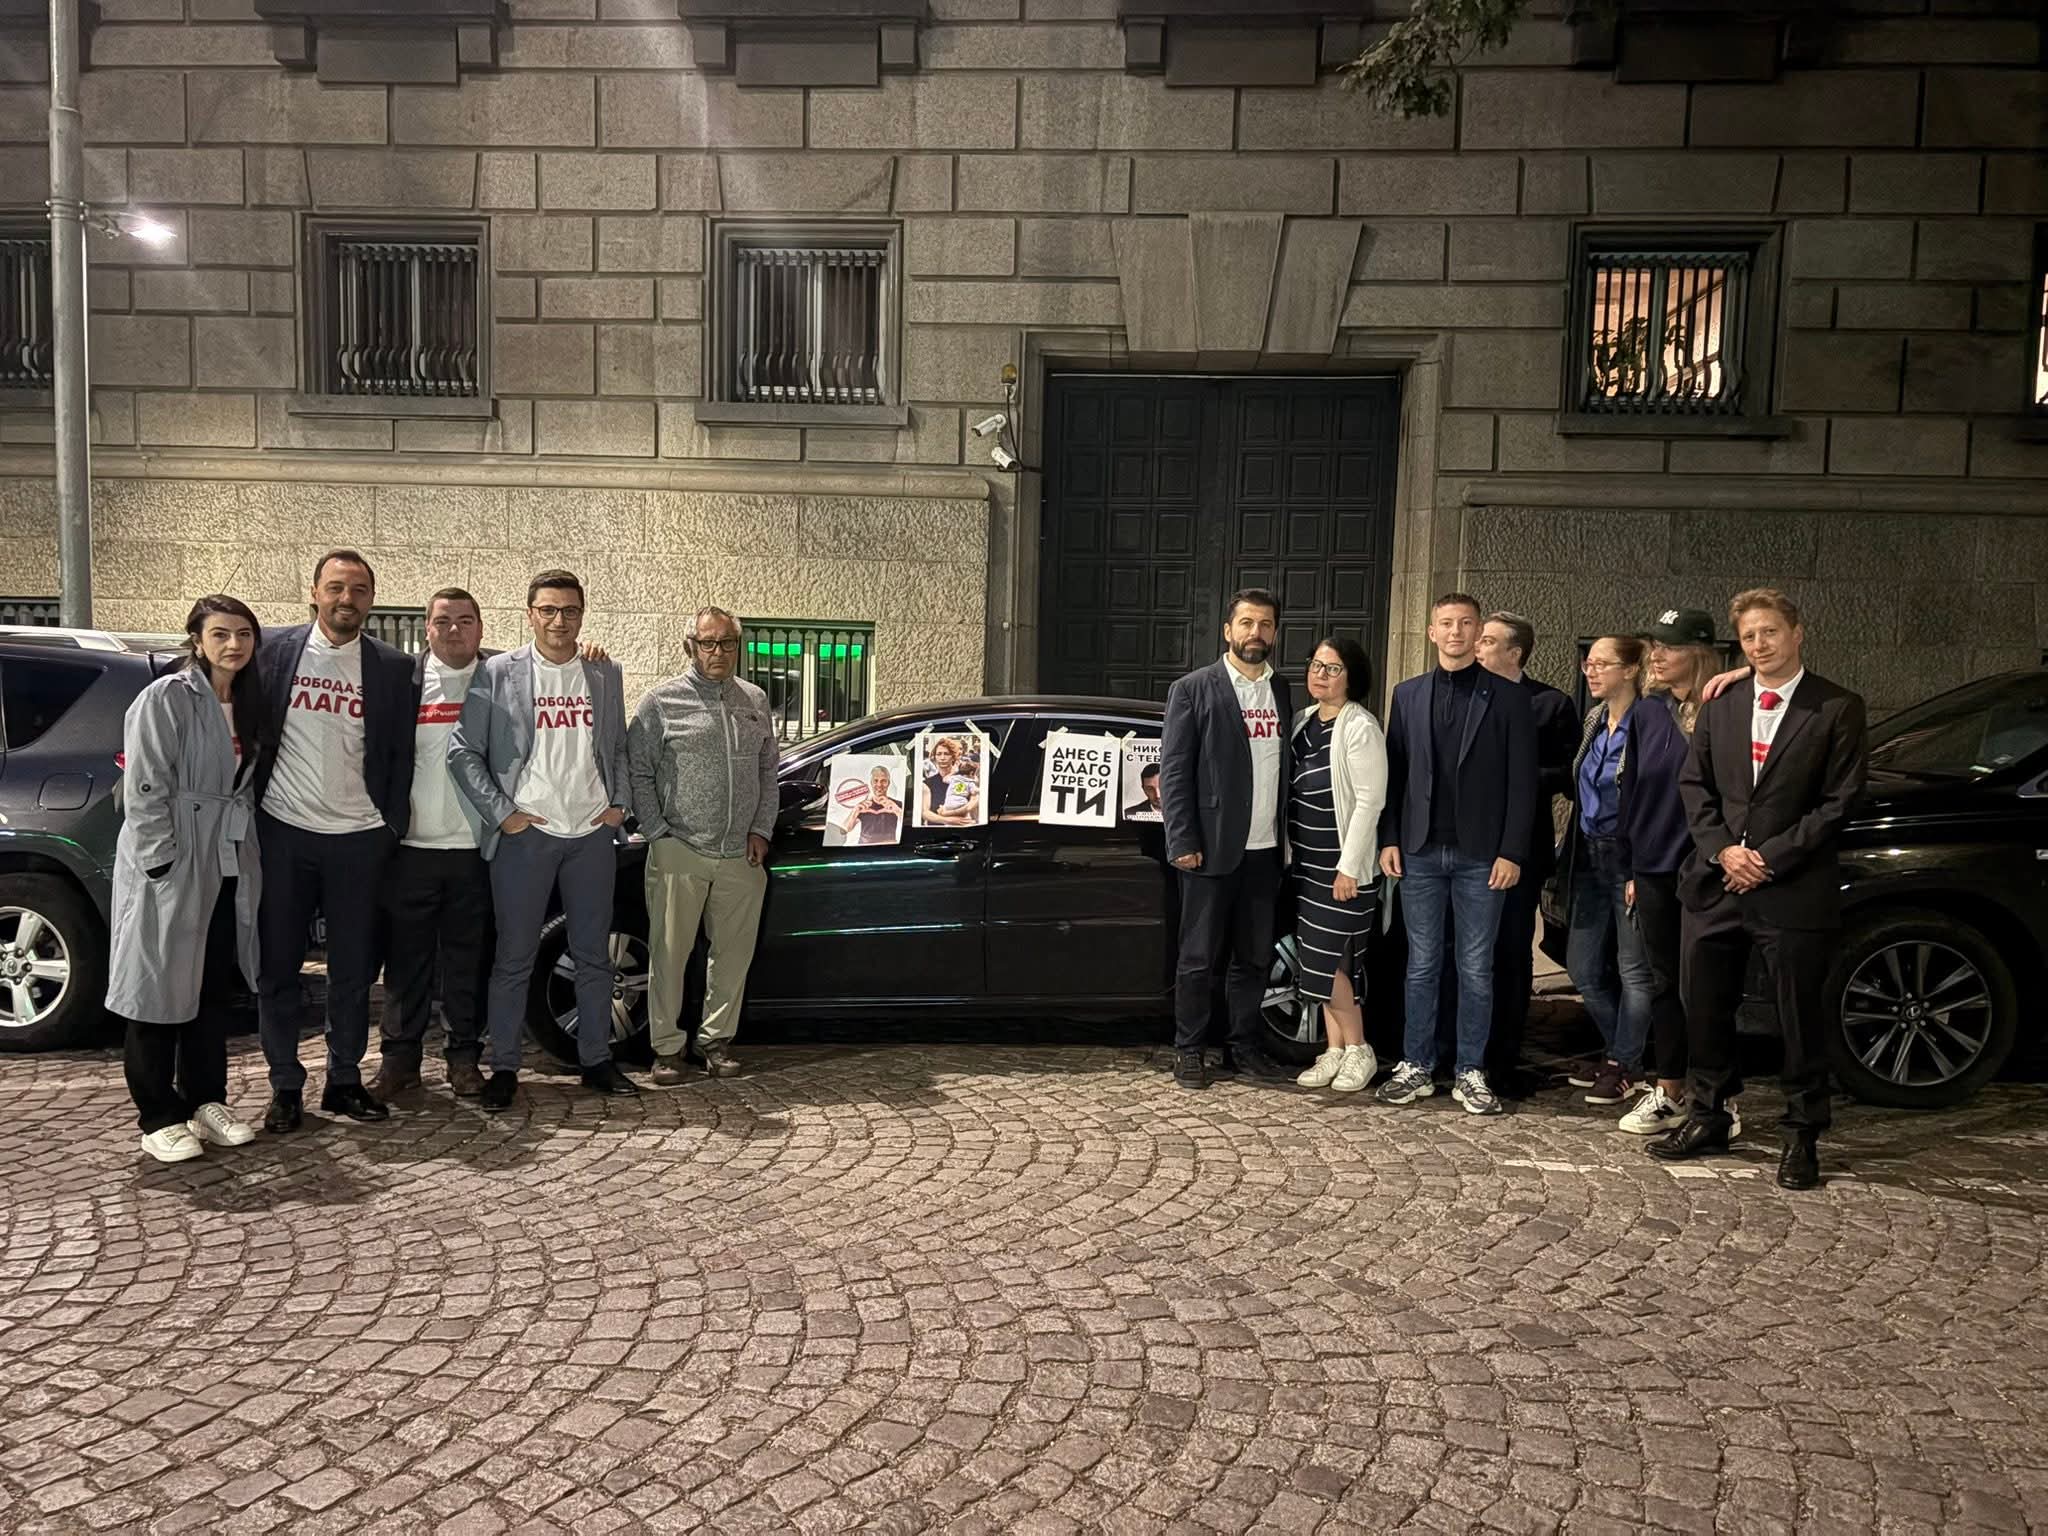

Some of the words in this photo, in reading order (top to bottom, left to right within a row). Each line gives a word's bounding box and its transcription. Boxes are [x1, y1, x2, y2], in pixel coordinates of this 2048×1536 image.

[292, 675, 354, 694] ВОБОДА
[288, 690, 366, 719] ЛАГО
[533, 696, 585, 708] ОБОДА
[536, 709, 593, 729] ЛАГО
[1240, 708, 1277, 720] ОБОДА
[1052, 747, 1098, 761] ДНЕС
[1103, 751, 1112, 763] Е
[1053, 760, 1111, 777] БЛАГО
[1051, 774, 1084, 787] УТРЕ
[1088, 778, 1108, 789] СИ
[1050, 785, 1106, 816] ТИ
